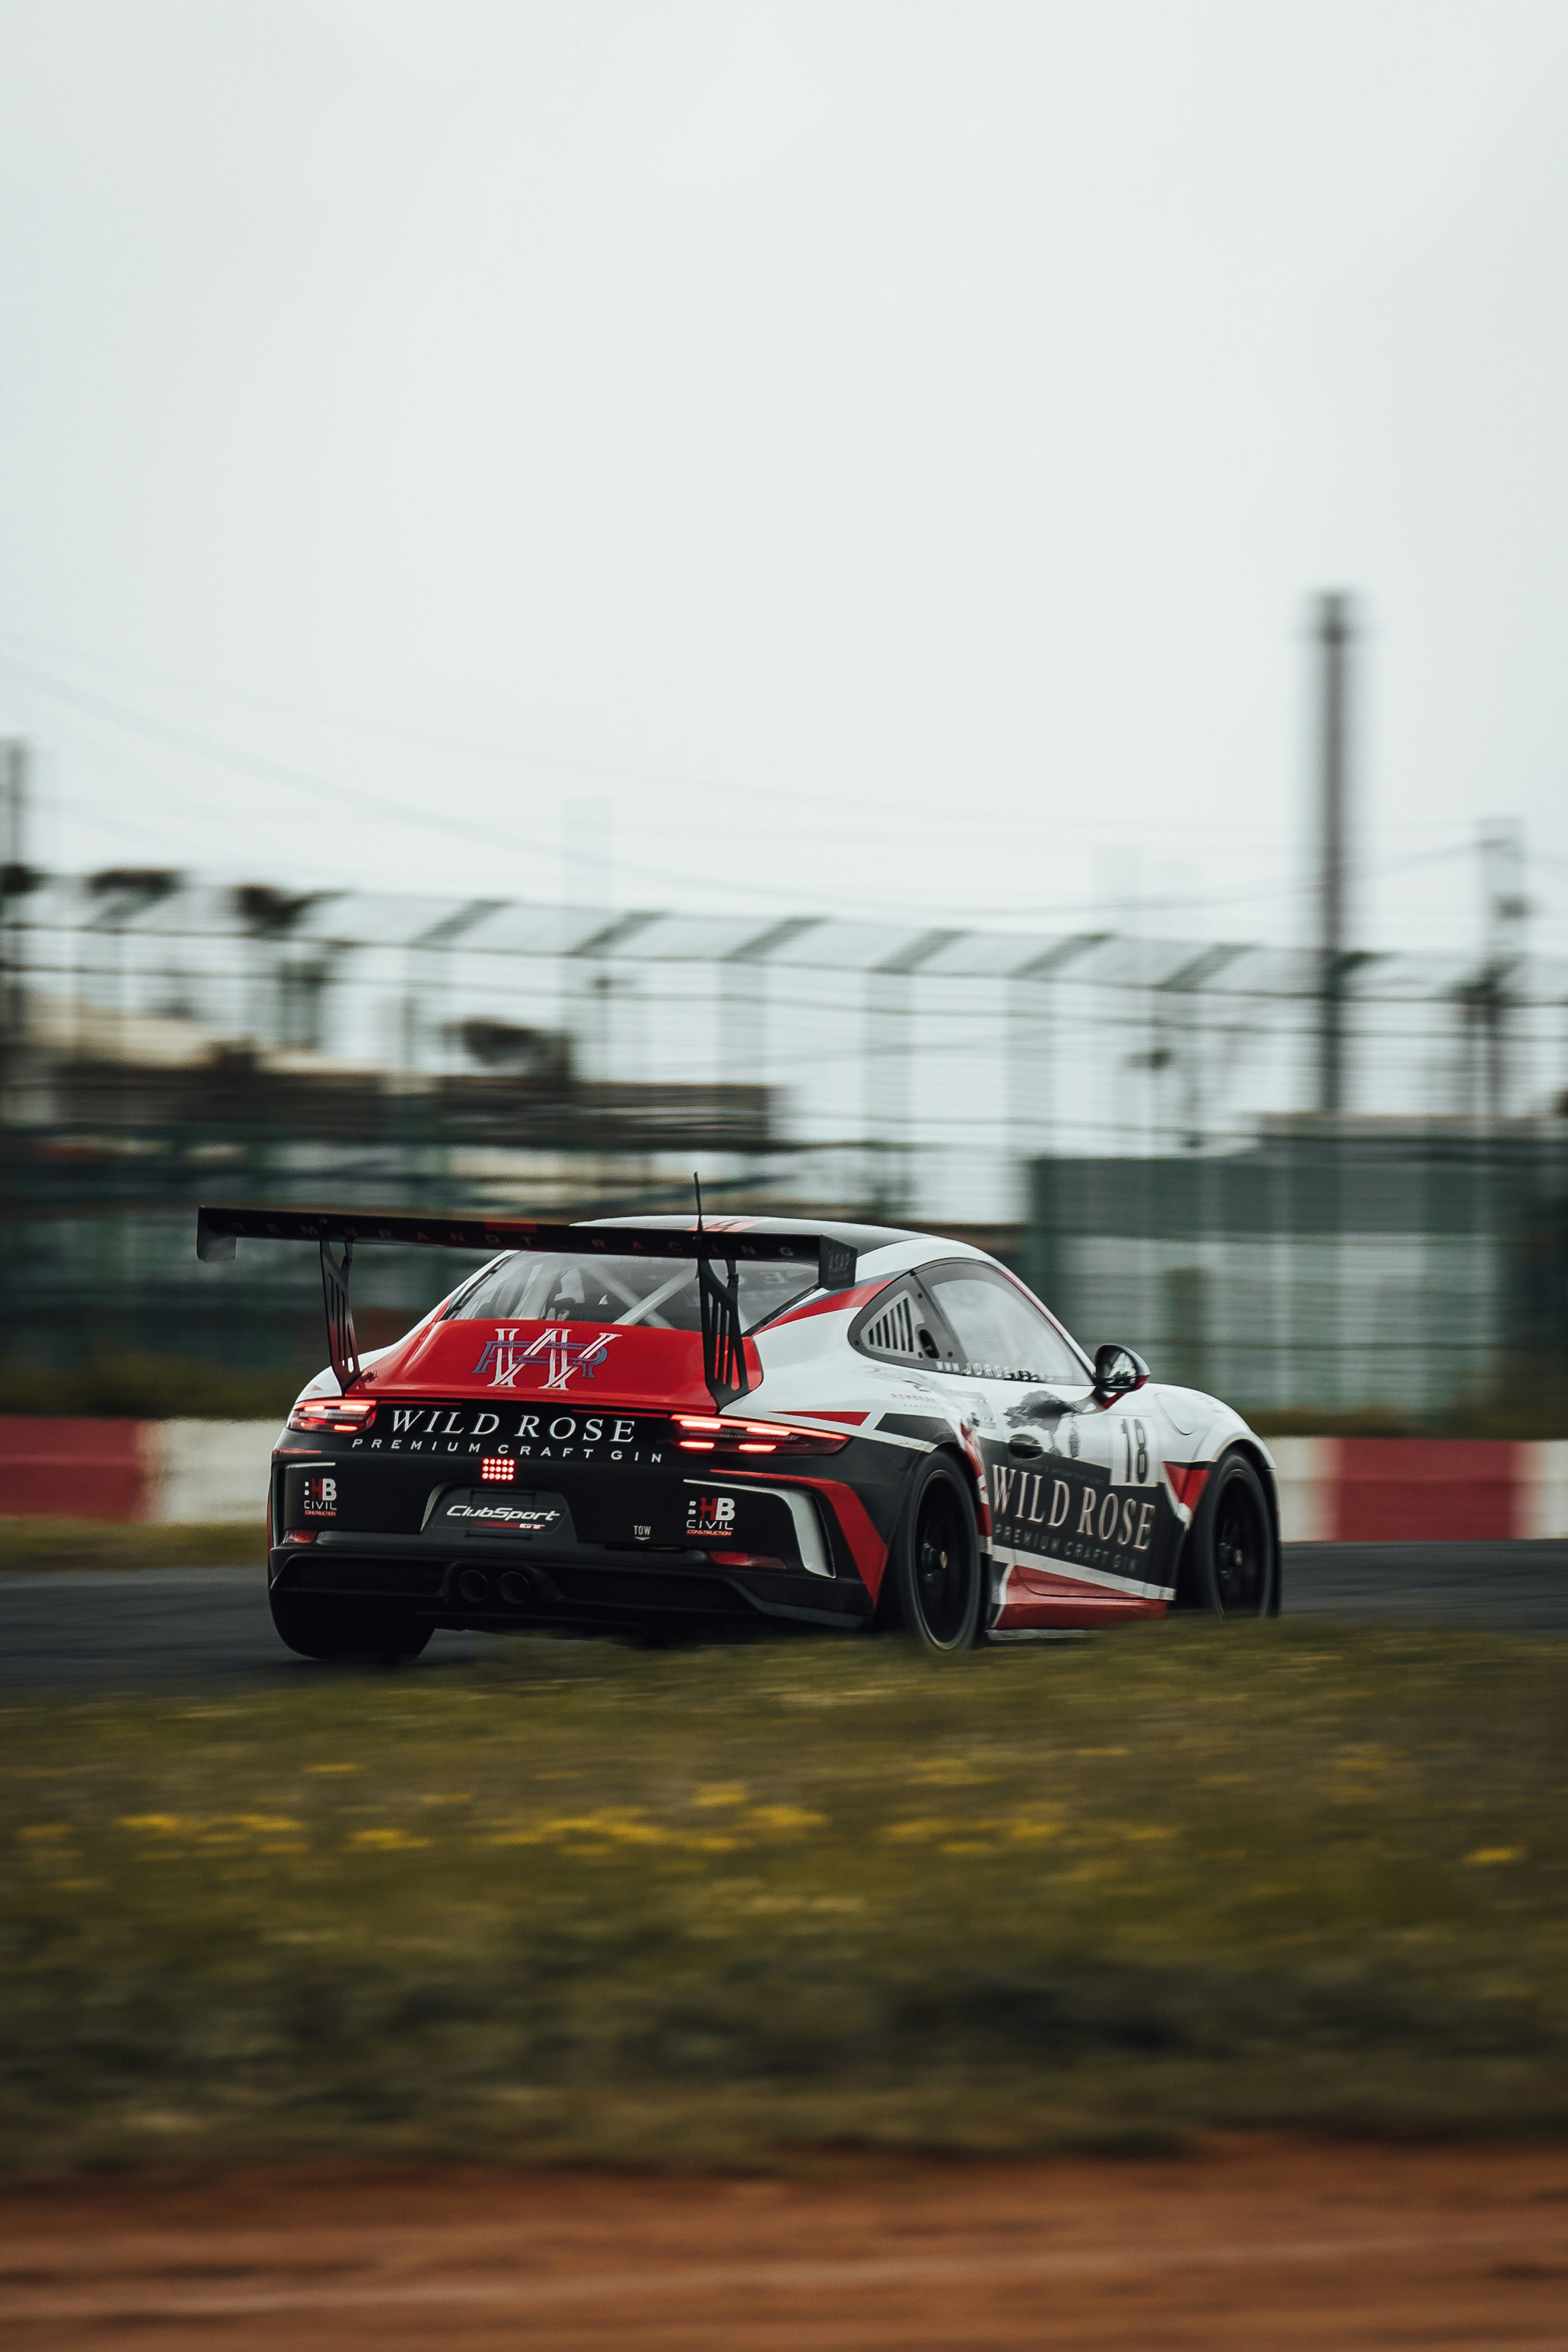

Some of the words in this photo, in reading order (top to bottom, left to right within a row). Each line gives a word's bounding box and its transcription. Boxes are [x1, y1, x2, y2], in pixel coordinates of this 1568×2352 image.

[230, 1220, 533, 1246] REMBRANDT
[591, 1239, 794, 1257] RACING
[392, 1409, 500, 1436] WILD
[514, 1414, 636, 1442] ROSE
[352, 1439, 481, 1454] PREMIUM
[497, 1443, 595, 1459] CRAFT
[610, 1451, 663, 1463] GIN
[1120, 1418, 1149, 1484] 18
[304, 1500, 337, 1510] CIVIL
[446, 1505, 561, 1521] ClubSport
[687, 1497, 736, 1521] BHB
[991, 1463, 1070, 1528] WILD
[1076, 1486, 1156, 1552] ROSE
[633, 1525, 651, 1535] TOW
[686, 1519, 734, 1530] CIVIL
[993, 1523, 1061, 1553] PREMIUM
[1064, 1541, 1110, 1565] CRAFT
[1112, 1553, 1138, 1573] GIN
